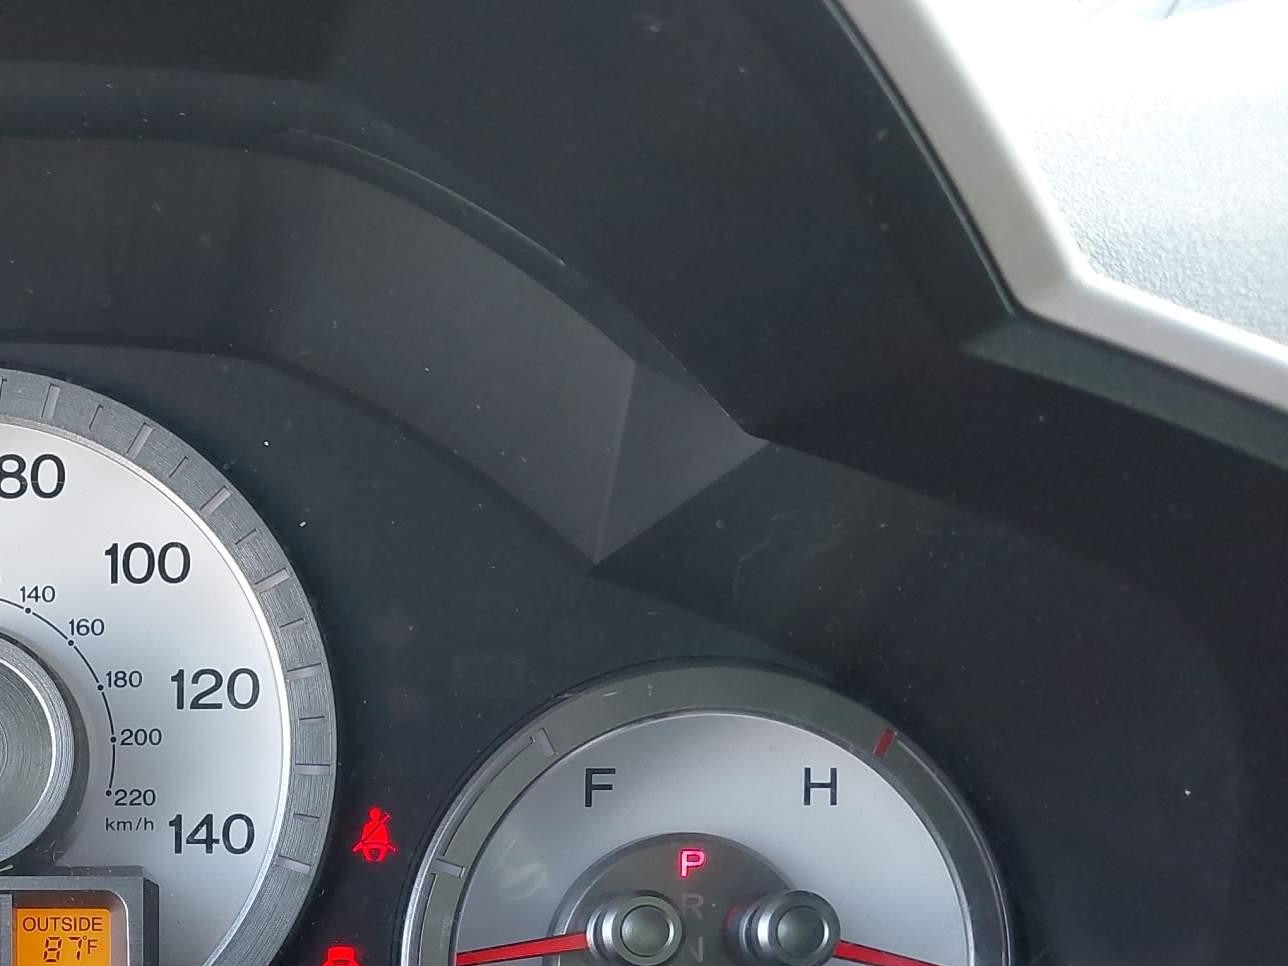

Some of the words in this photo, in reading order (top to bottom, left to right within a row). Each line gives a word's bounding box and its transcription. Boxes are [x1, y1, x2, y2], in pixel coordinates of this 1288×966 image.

[105, 542, 190, 584] 100
[18, 584, 56, 605] 140
[68, 618, 105, 638] 160
[105, 670, 143, 689] 180
[171, 668, 259, 709] 120
[120, 729, 161, 745] 200
[113, 788, 156, 807] 220
[585, 768, 616, 807] F
[804, 768, 837, 805] H
[106, 818, 153, 831] km/h
[169, 814, 254, 854] 140
[679, 848, 705, 876] P
[680, 893, 702, 920] R
[23, 917, 102, 931] OUTSIDE
[683, 935, 702, 963] N
